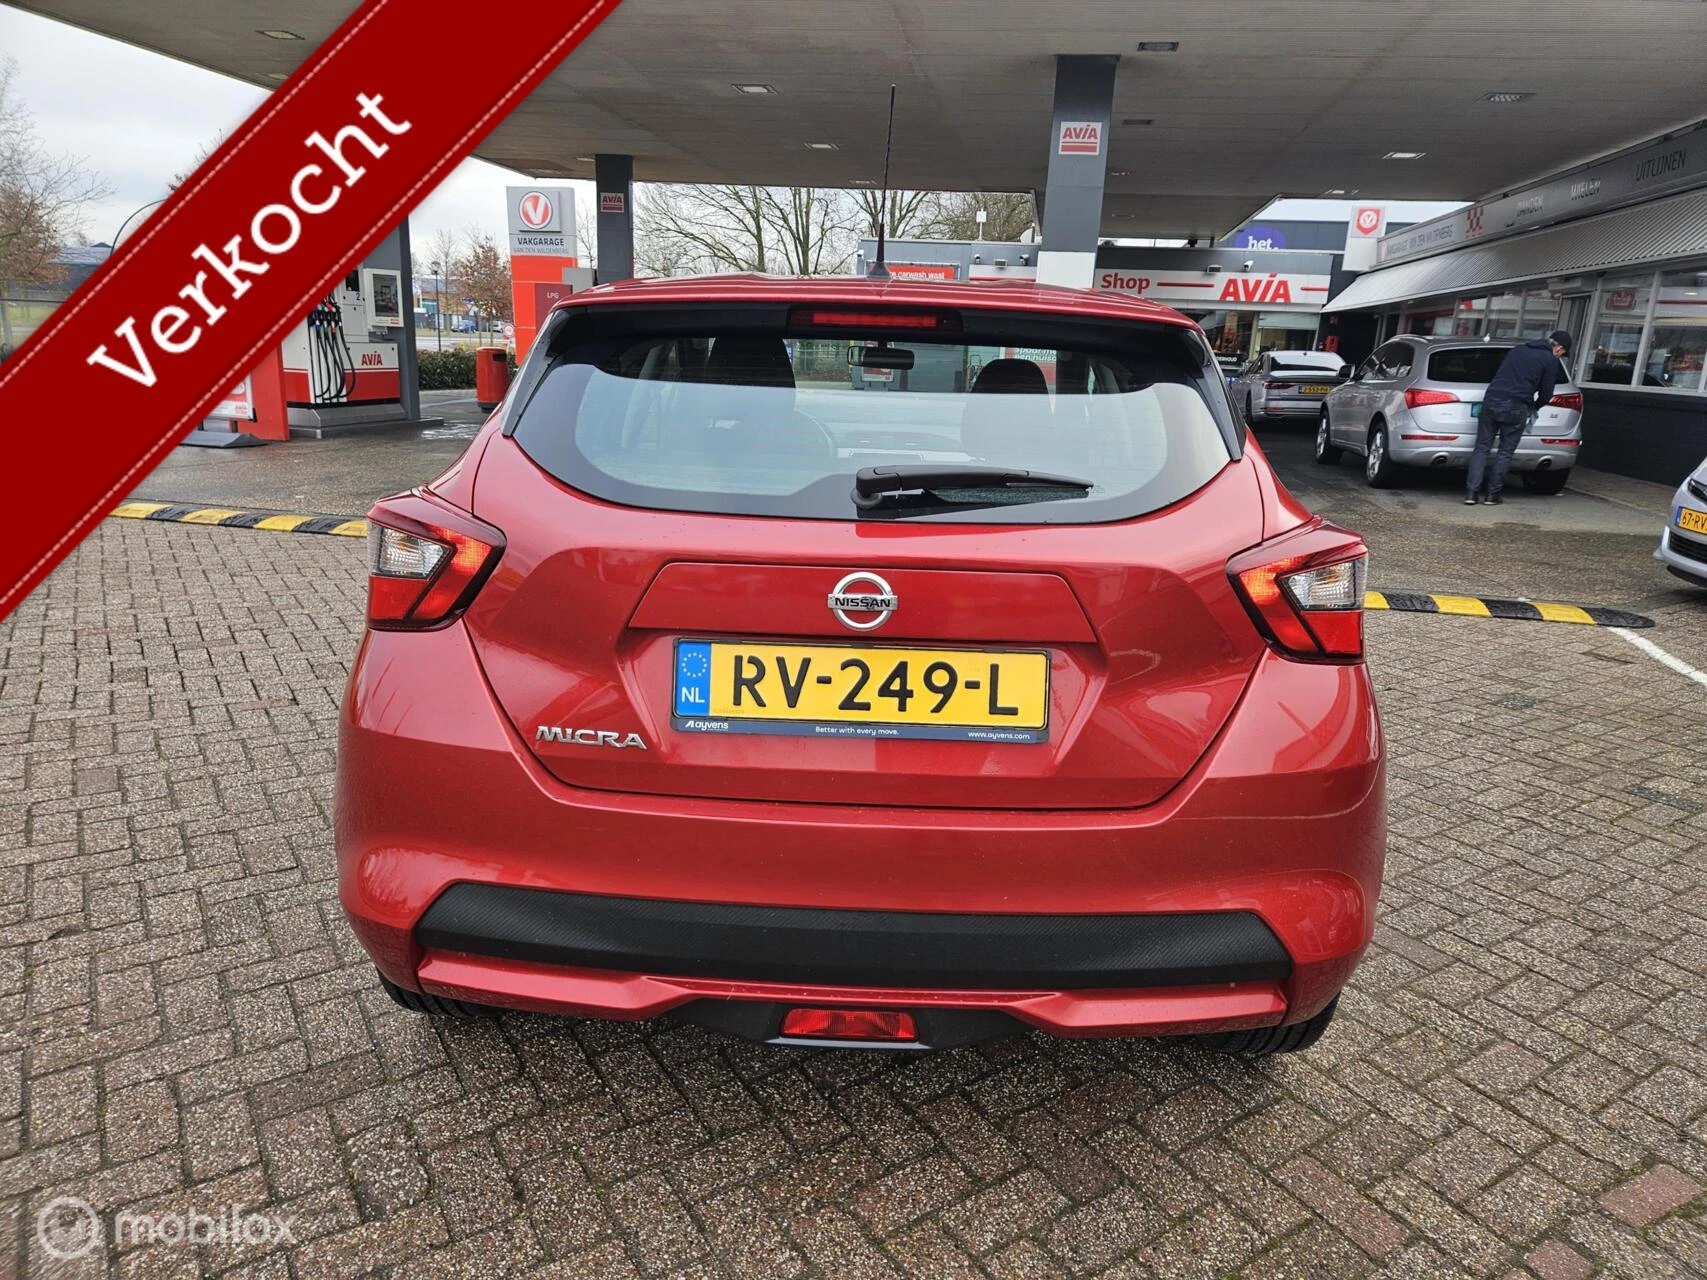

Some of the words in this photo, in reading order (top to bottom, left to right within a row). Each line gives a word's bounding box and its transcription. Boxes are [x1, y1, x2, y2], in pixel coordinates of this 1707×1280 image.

[518, 237, 564, 246] VAKGARAGE
[1101, 272, 1150, 294] Shop
[835, 597, 891, 608] NISSAN
[732, 654, 1018, 716] RV-249-L
[681, 686, 705, 704] NL
[536, 725, 648, 750] MICRA
[839, 726, 855, 734] with
[857, 728, 876, 736] every
[878, 728, 900, 736] move.
[968, 731, 1030, 740] www.ayvens.com
